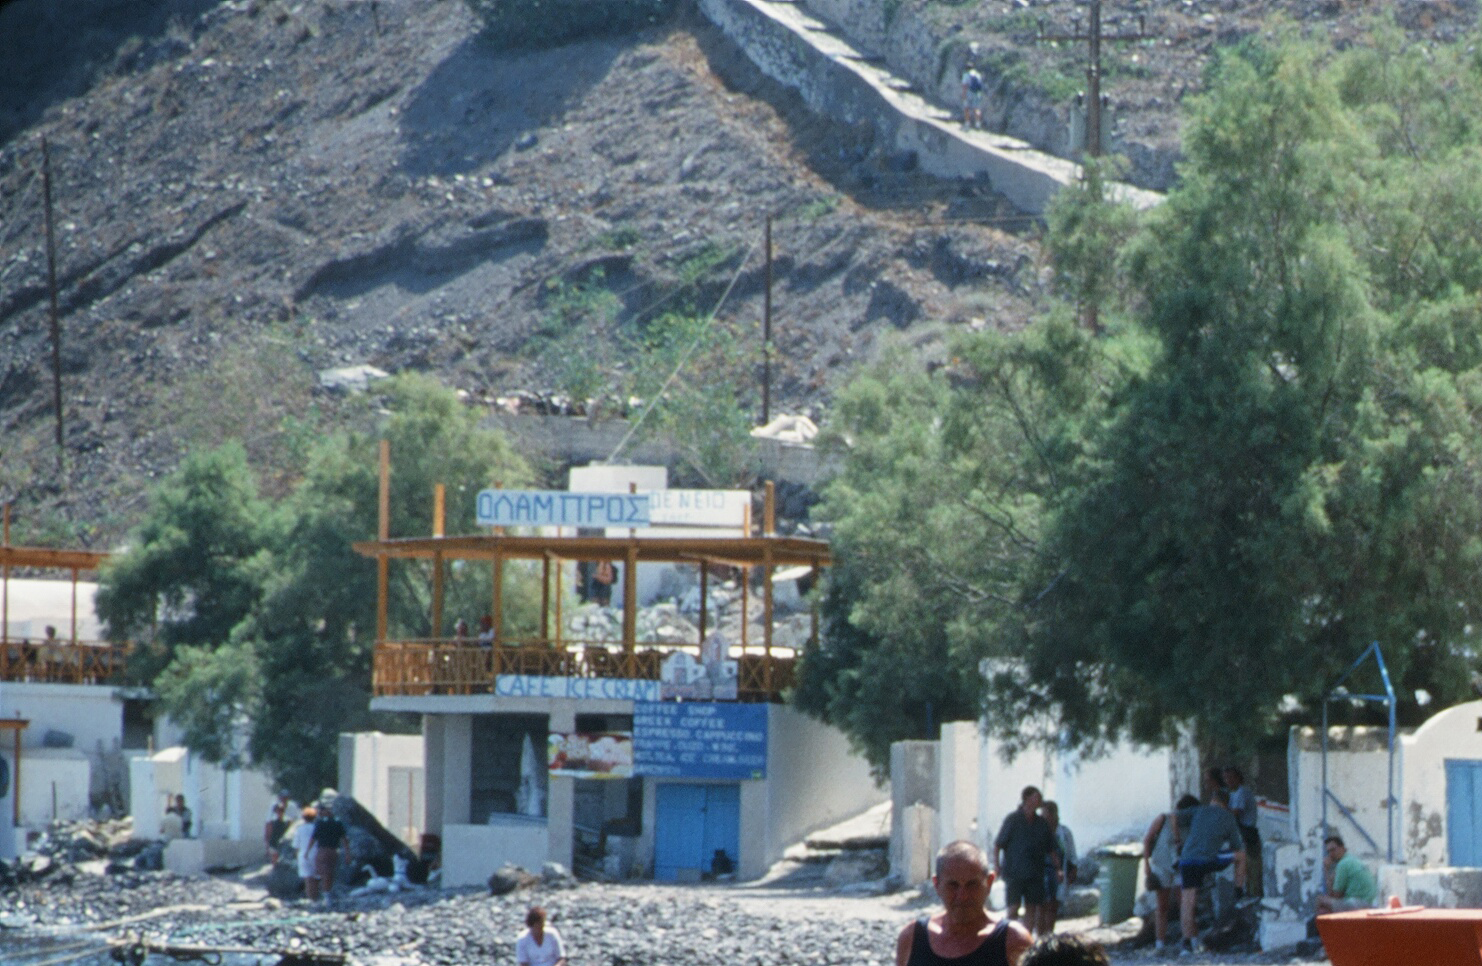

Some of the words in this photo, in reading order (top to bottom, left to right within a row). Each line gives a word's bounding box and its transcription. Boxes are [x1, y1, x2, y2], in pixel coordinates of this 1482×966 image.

[496, 675, 551, 697] CAFE
[565, 677, 595, 699] ICE
[602, 679, 659, 700] CREAM
[680, 717, 725, 729] COFFEE
